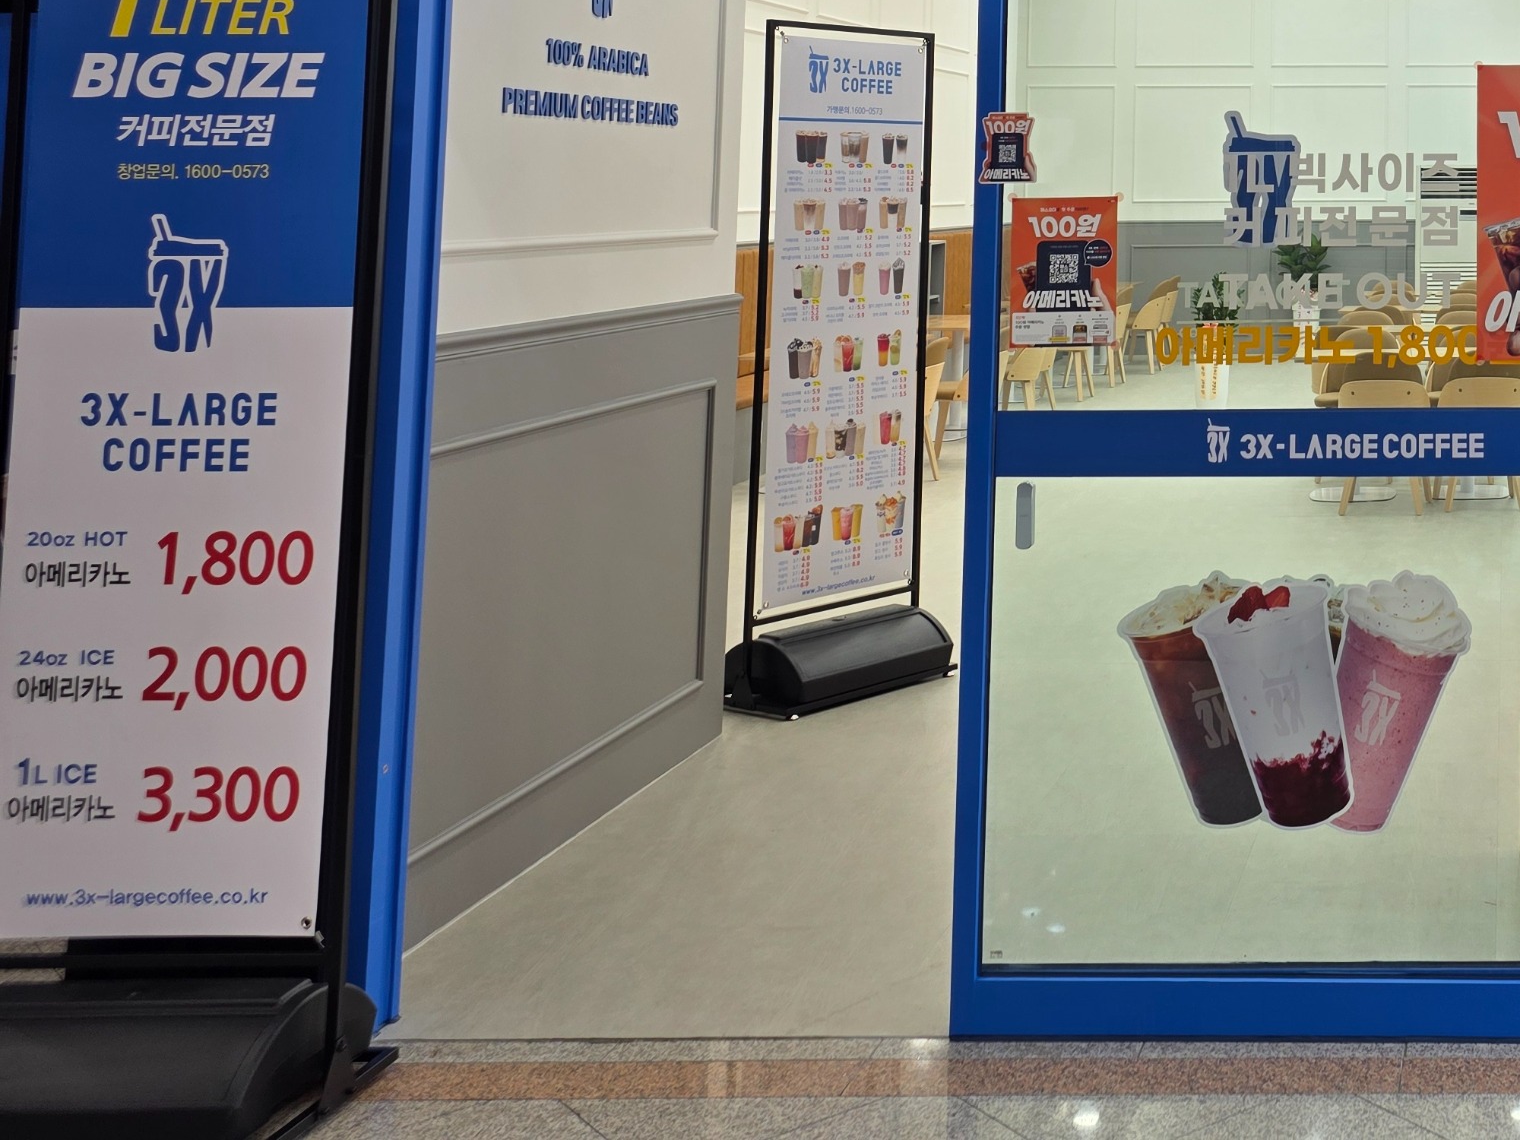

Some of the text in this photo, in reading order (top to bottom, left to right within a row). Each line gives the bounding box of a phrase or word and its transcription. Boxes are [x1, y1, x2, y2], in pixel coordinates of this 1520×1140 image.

[546, 38, 649, 77] 100% ARABICA
[833, 58, 902, 77] 3X-LARGE
[72, 52, 325, 99] BIG SIZE
[841, 77, 893, 94] COFFEE
[502, 87, 679, 127] PREMIUM COFFEE BEANS
[116, 114, 276, 147] 커피전문점
[986, 120, 1030, 134] 100원
[184, 163, 270, 180] 1600-0573
[984, 168, 1030, 180] 아메리카노
[1290, 153, 1460, 194] 빅사이즈
[1028, 214, 1101, 238] 100원
[1223, 205, 1460, 248] 커피전문점
[1022, 289, 1104, 308] 아메리카노
[1219, 272, 1343, 310] TAKE
[1356, 272, 1462, 310] OUT
[1156, 325, 1357, 366] 아메리카노
[80, 392, 278, 427] 3X-LARGE
[102, 438, 250, 472] COFFEE
[1382, 432, 1485, 459] COFFEE
[27, 531, 128, 548] 20oz HOT
[25, 561, 131, 589] 아메리카노
[157, 530, 314, 595] 1,800
[18, 649, 115, 666] 24oz ICE
[16, 675, 123, 702] 아메리카노
[141, 645, 307, 711] 2,000
[17, 758, 97, 786] 1L ICE
[7, 795, 115, 822] 아메리카노
[136, 765, 299, 832] 3,300
[25, 887, 268, 908] www.3x-largecoffee.co.kr
